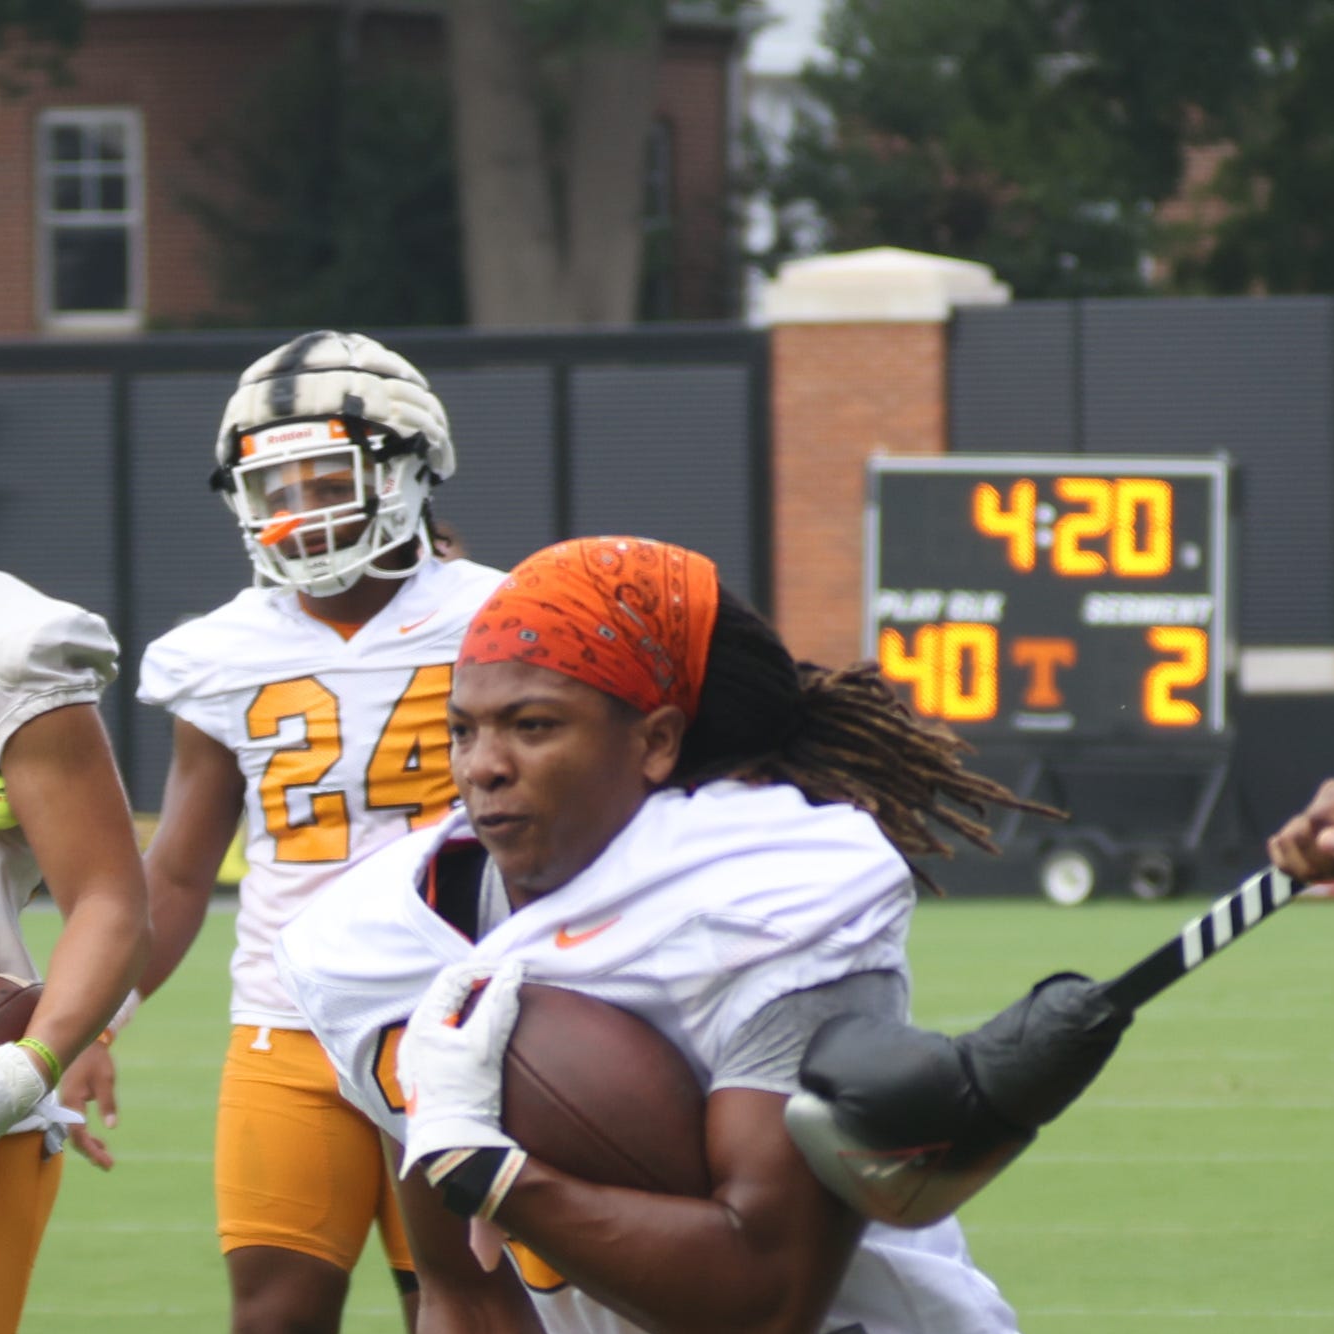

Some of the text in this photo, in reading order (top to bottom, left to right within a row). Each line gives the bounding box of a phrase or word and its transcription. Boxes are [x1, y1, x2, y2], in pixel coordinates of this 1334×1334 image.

[973, 477, 1173, 577] 4:20
[878, 621, 999, 722] 40
[1011, 638, 1076, 706] T
[1141, 624, 1210, 725] 2
[245, 662, 460, 865] 24
